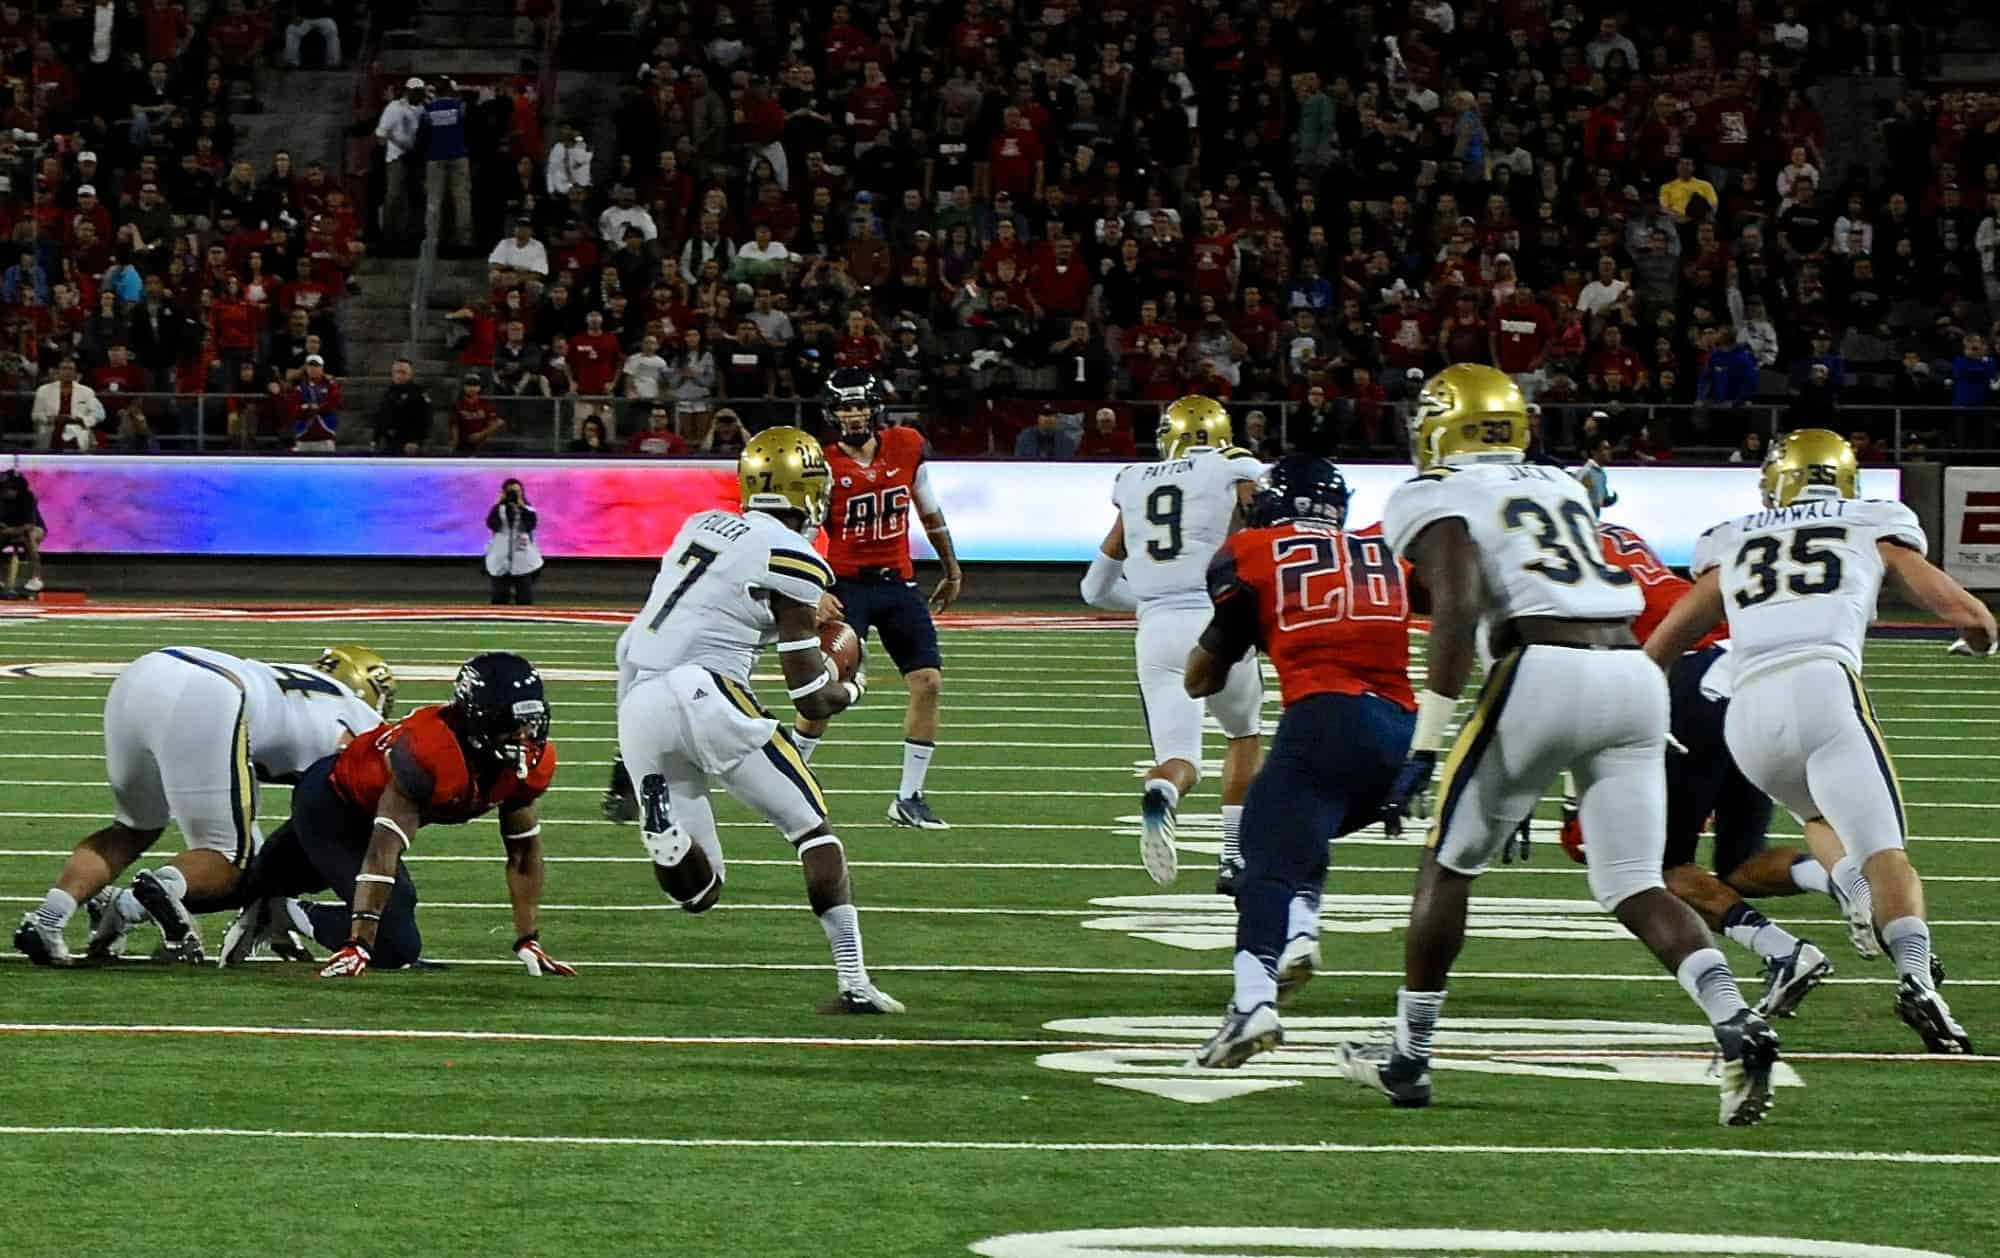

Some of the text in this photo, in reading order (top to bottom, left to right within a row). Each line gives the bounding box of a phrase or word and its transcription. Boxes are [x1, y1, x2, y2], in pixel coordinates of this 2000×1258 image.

[1073, 355, 1087, 383] 1
[1143, 458, 1197, 480] PAYTON
[1807, 464, 1837, 485] 35
[1146, 484, 1183, 563] 9
[1502, 498, 1634, 586] 30
[1743, 500, 1847, 532] ZUMWALT
[648, 541, 719, 633] 7
[1273, 534, 1408, 632] 28
[1734, 526, 1847, 609] 35
